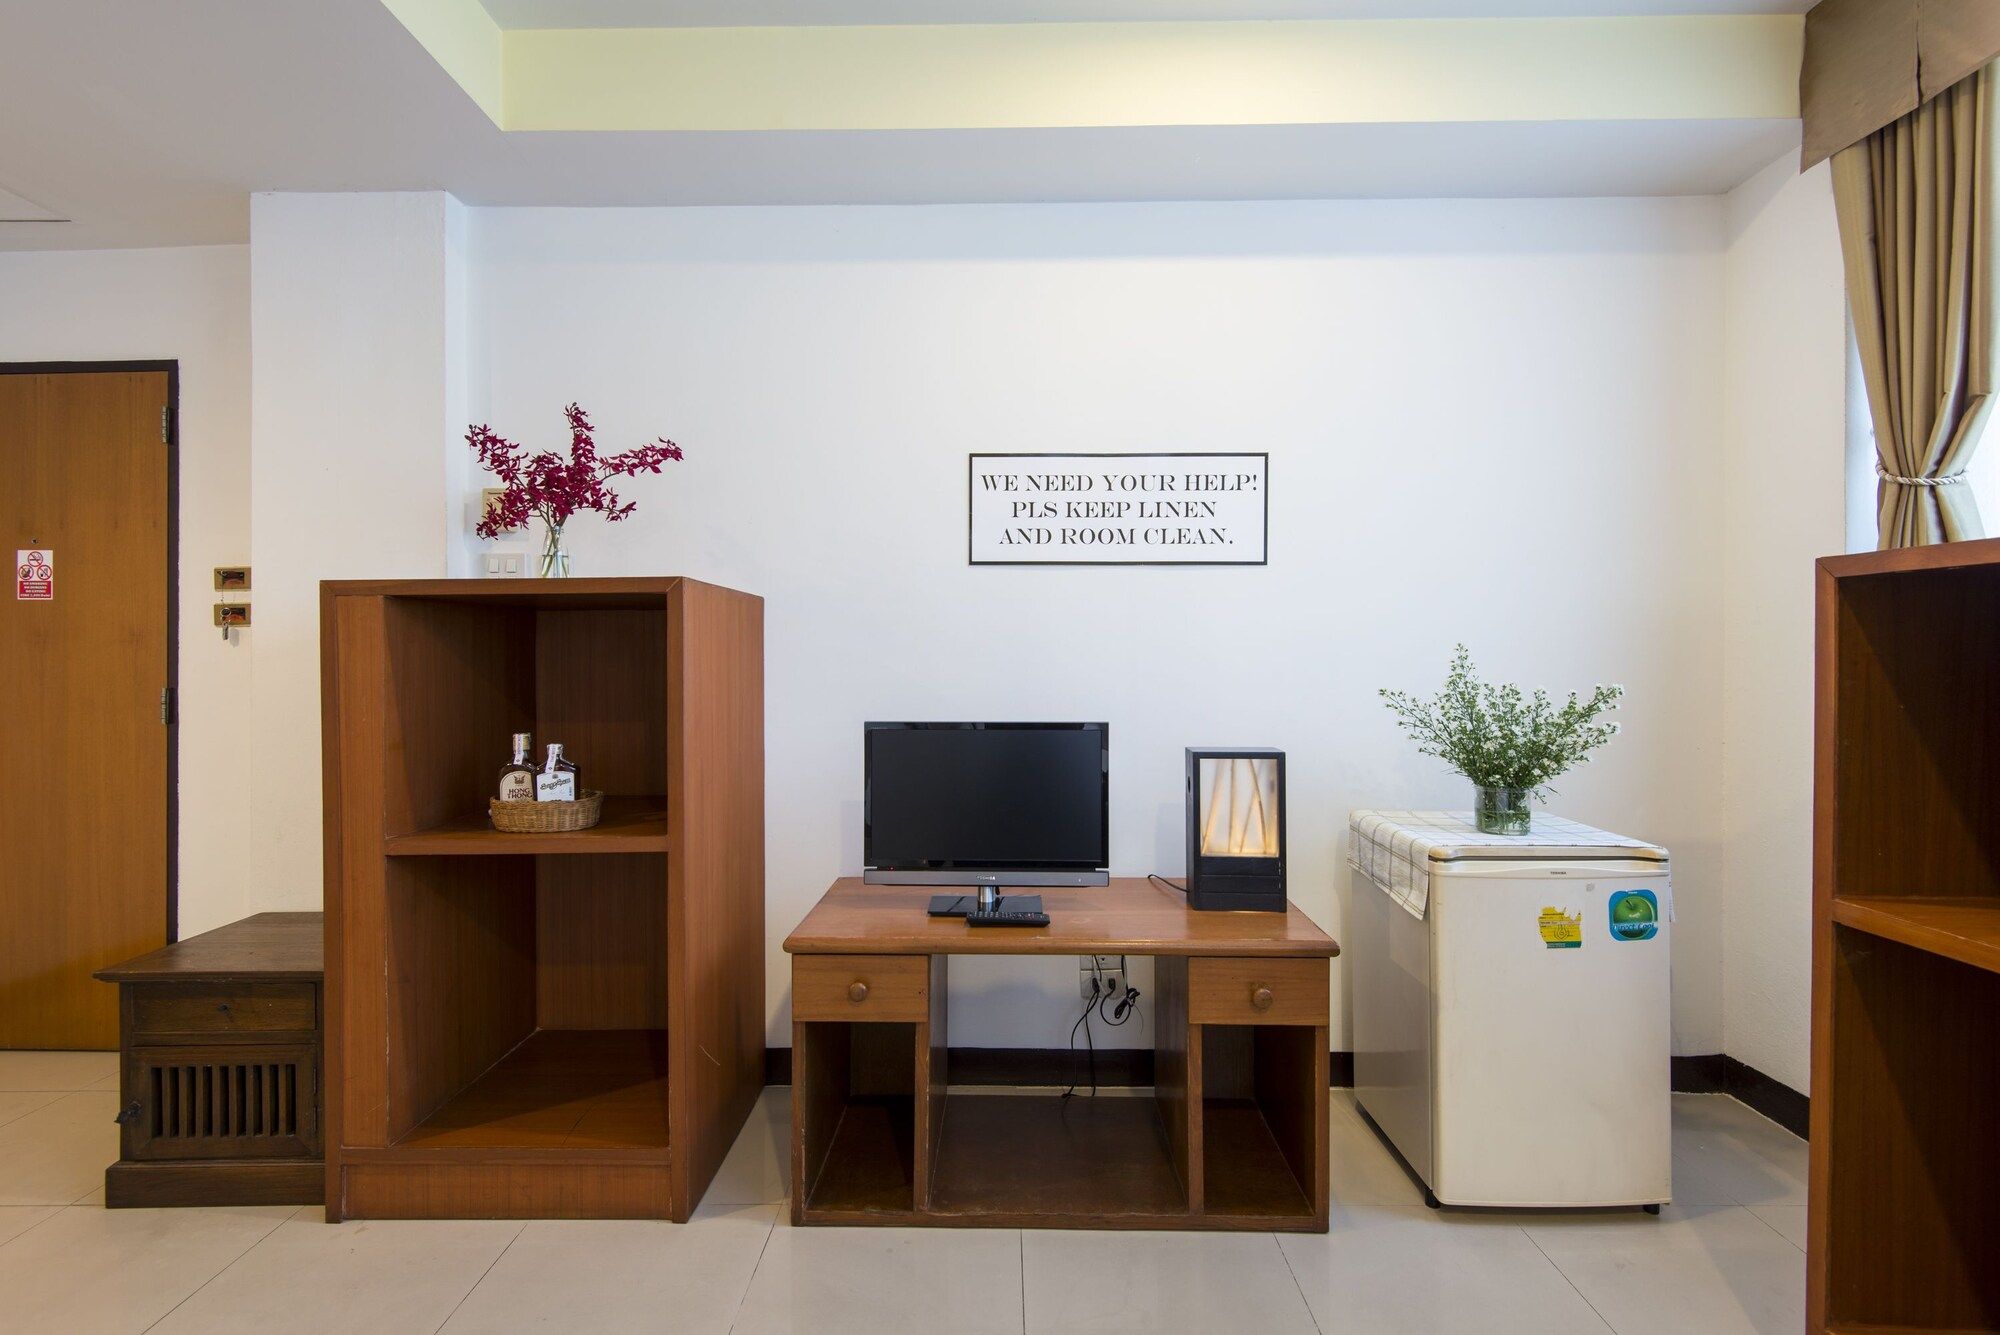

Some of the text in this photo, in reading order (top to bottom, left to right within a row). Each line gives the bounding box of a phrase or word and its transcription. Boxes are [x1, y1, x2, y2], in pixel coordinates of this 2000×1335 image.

[981, 474, 1257, 491] WE NEED YOUR HELP!
[1012, 501, 1217, 518] PLS KEEP LINEN
[999, 528, 1234, 545] AND ROOM CLEAN.
